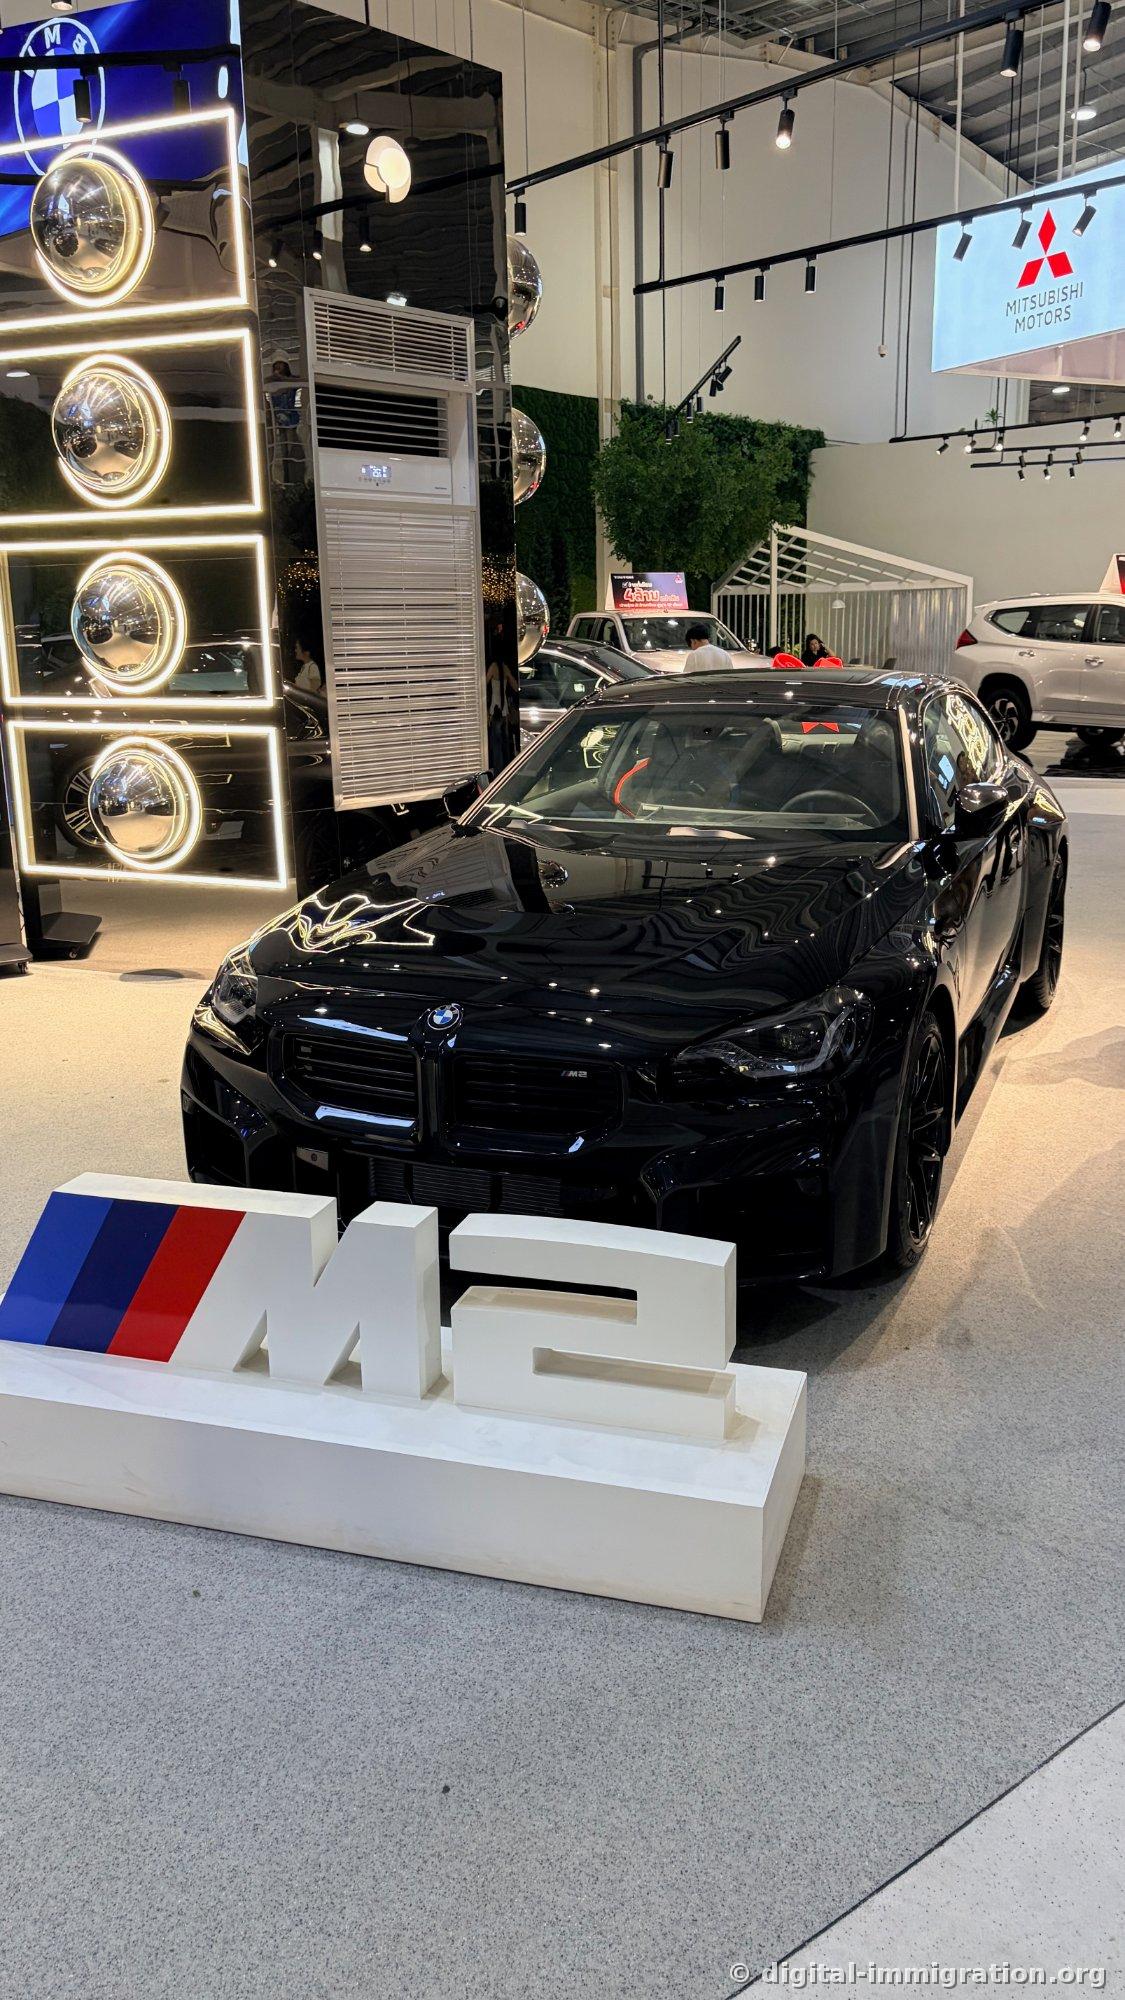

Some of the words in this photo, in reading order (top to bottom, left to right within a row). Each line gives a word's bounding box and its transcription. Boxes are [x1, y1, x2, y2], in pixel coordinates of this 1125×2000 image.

[1005, 282, 1084, 317] MITSUBISHI
[1014, 304, 1072, 334] MOTORS
[168, 1204, 738, 1442] M2
